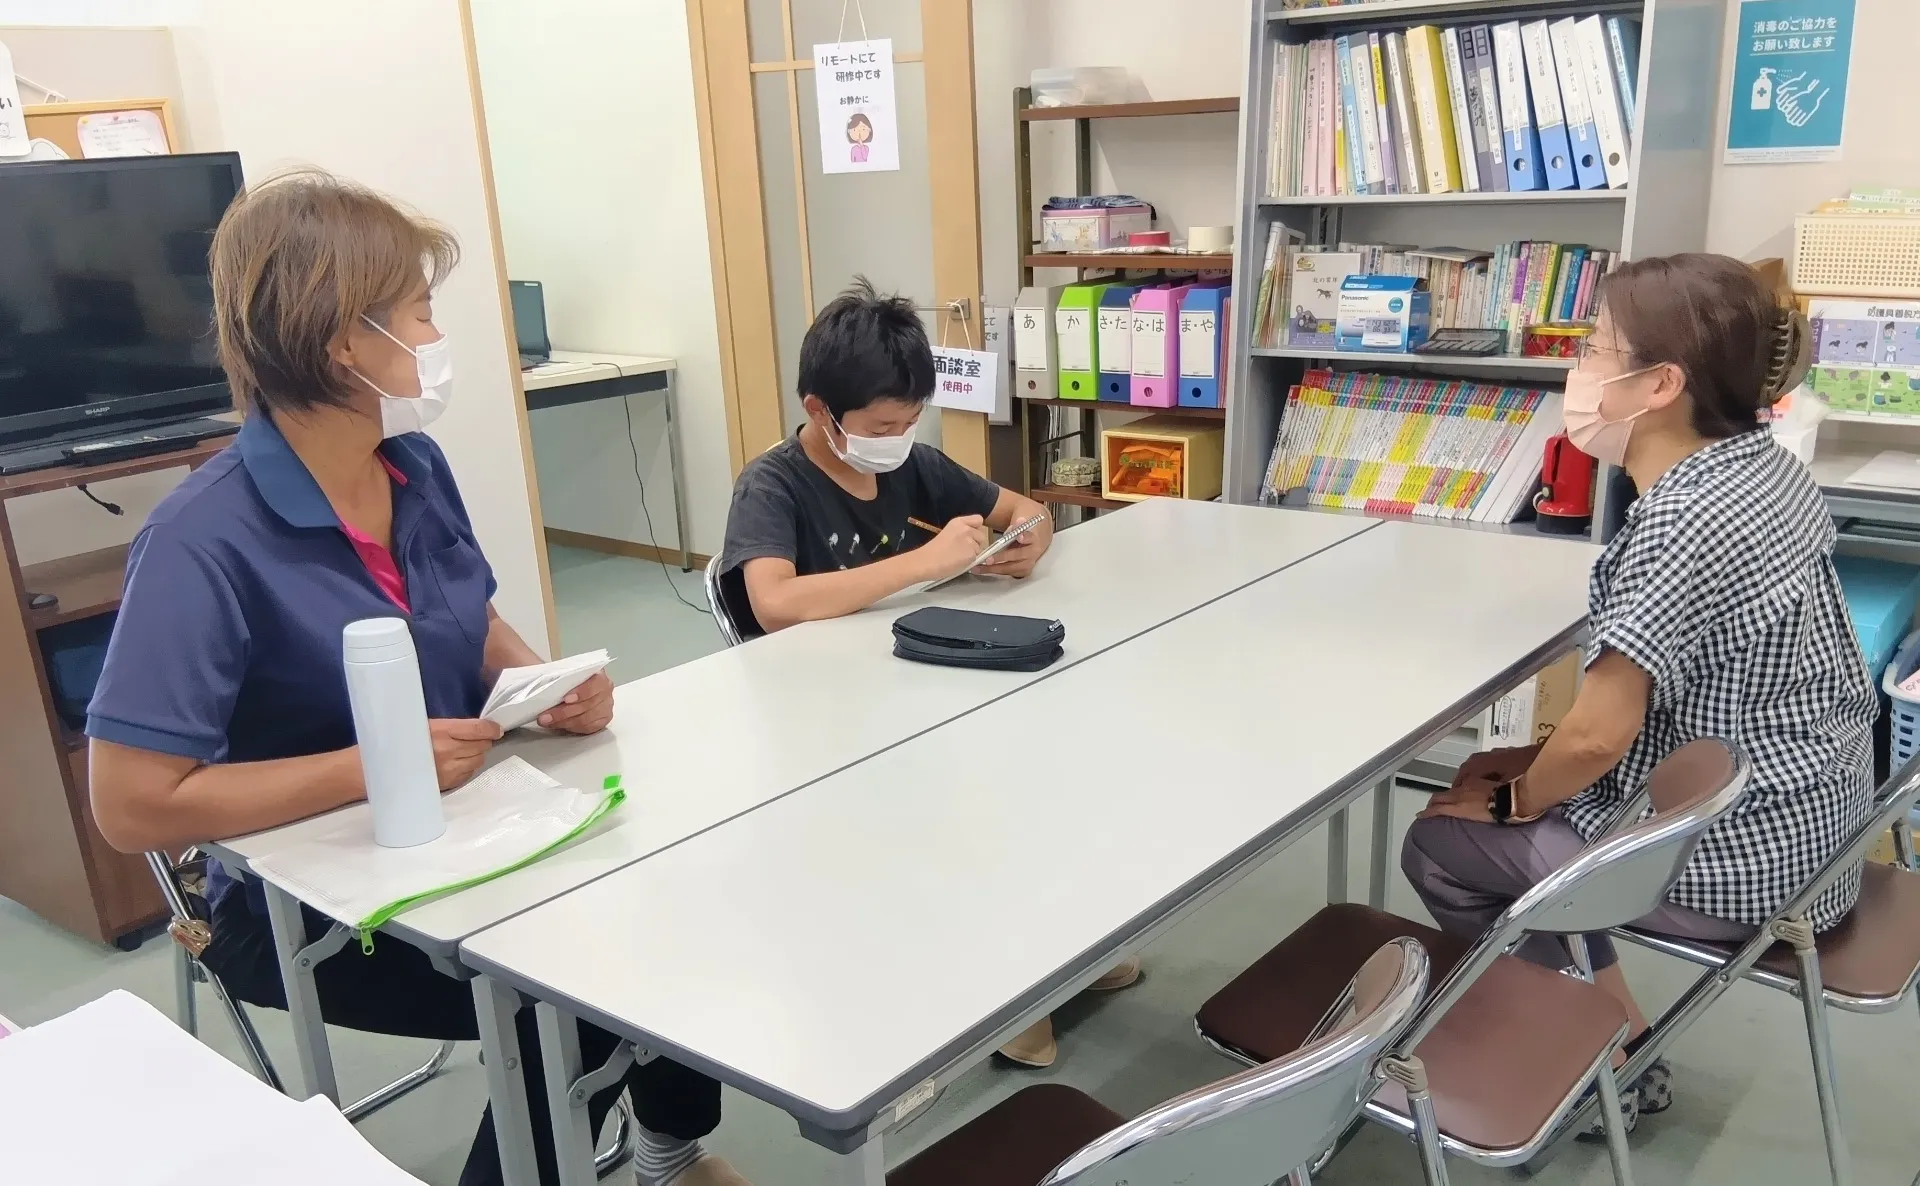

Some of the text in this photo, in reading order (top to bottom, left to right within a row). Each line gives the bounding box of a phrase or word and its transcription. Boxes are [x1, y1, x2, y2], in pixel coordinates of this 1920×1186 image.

[1753, 16, 1837, 33] 消毒のご協力を
[1752, 36, 1835, 52] お願い致します
[821, 52, 876, 66] リモートにて
[836, 70, 881, 82] 研修中です
[840, 96, 869, 105] お静かに
[1341, 294, 1369, 302] Panasonic
[1023, 313, 1036, 330] あ
[1067, 315, 1080, 330] か
[1099, 315, 1128, 330] さ・た
[1133, 317, 1165, 332] な・は
[1180, 318, 1214, 333] ま・や
[932, 355, 982, 378] 面談室
[942, 380, 973, 394] 使用中
[85, 406, 111, 416] SHARP
